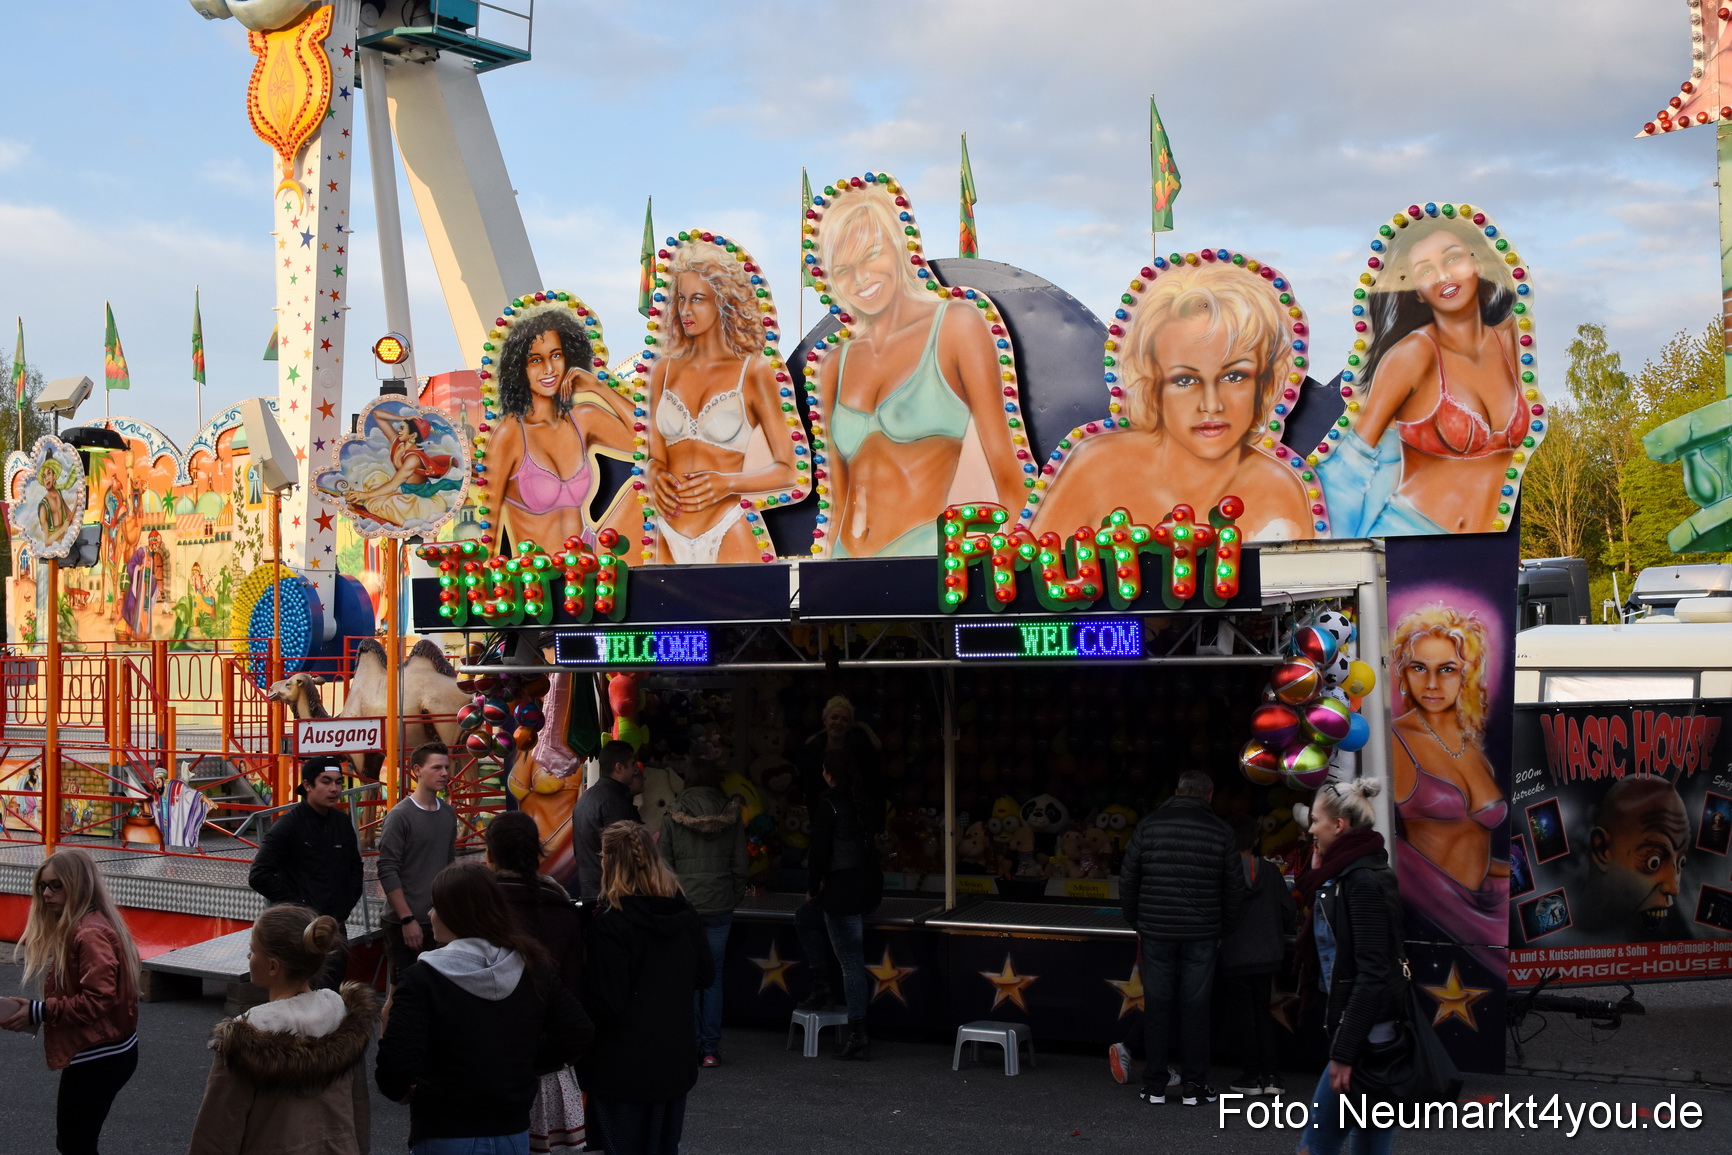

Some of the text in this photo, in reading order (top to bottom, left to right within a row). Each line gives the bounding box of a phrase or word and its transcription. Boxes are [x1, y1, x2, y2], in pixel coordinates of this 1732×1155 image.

[415, 495, 1244, 620] Tutti Frutti
[594, 635, 706, 660] WELCOME
[1020, 625, 1138, 654] WELCOM
[302, 726, 378, 748] Ausgang
[1540, 709, 1722, 787] MAGIC HOUSE
[1515, 768, 1543, 784] 200m
[1520, 951, 1537, 962] und
[1539, 950, 1547, 961] S.
[1618, 947, 1625, 957] &
[1626, 945, 1648, 957] Sohn
